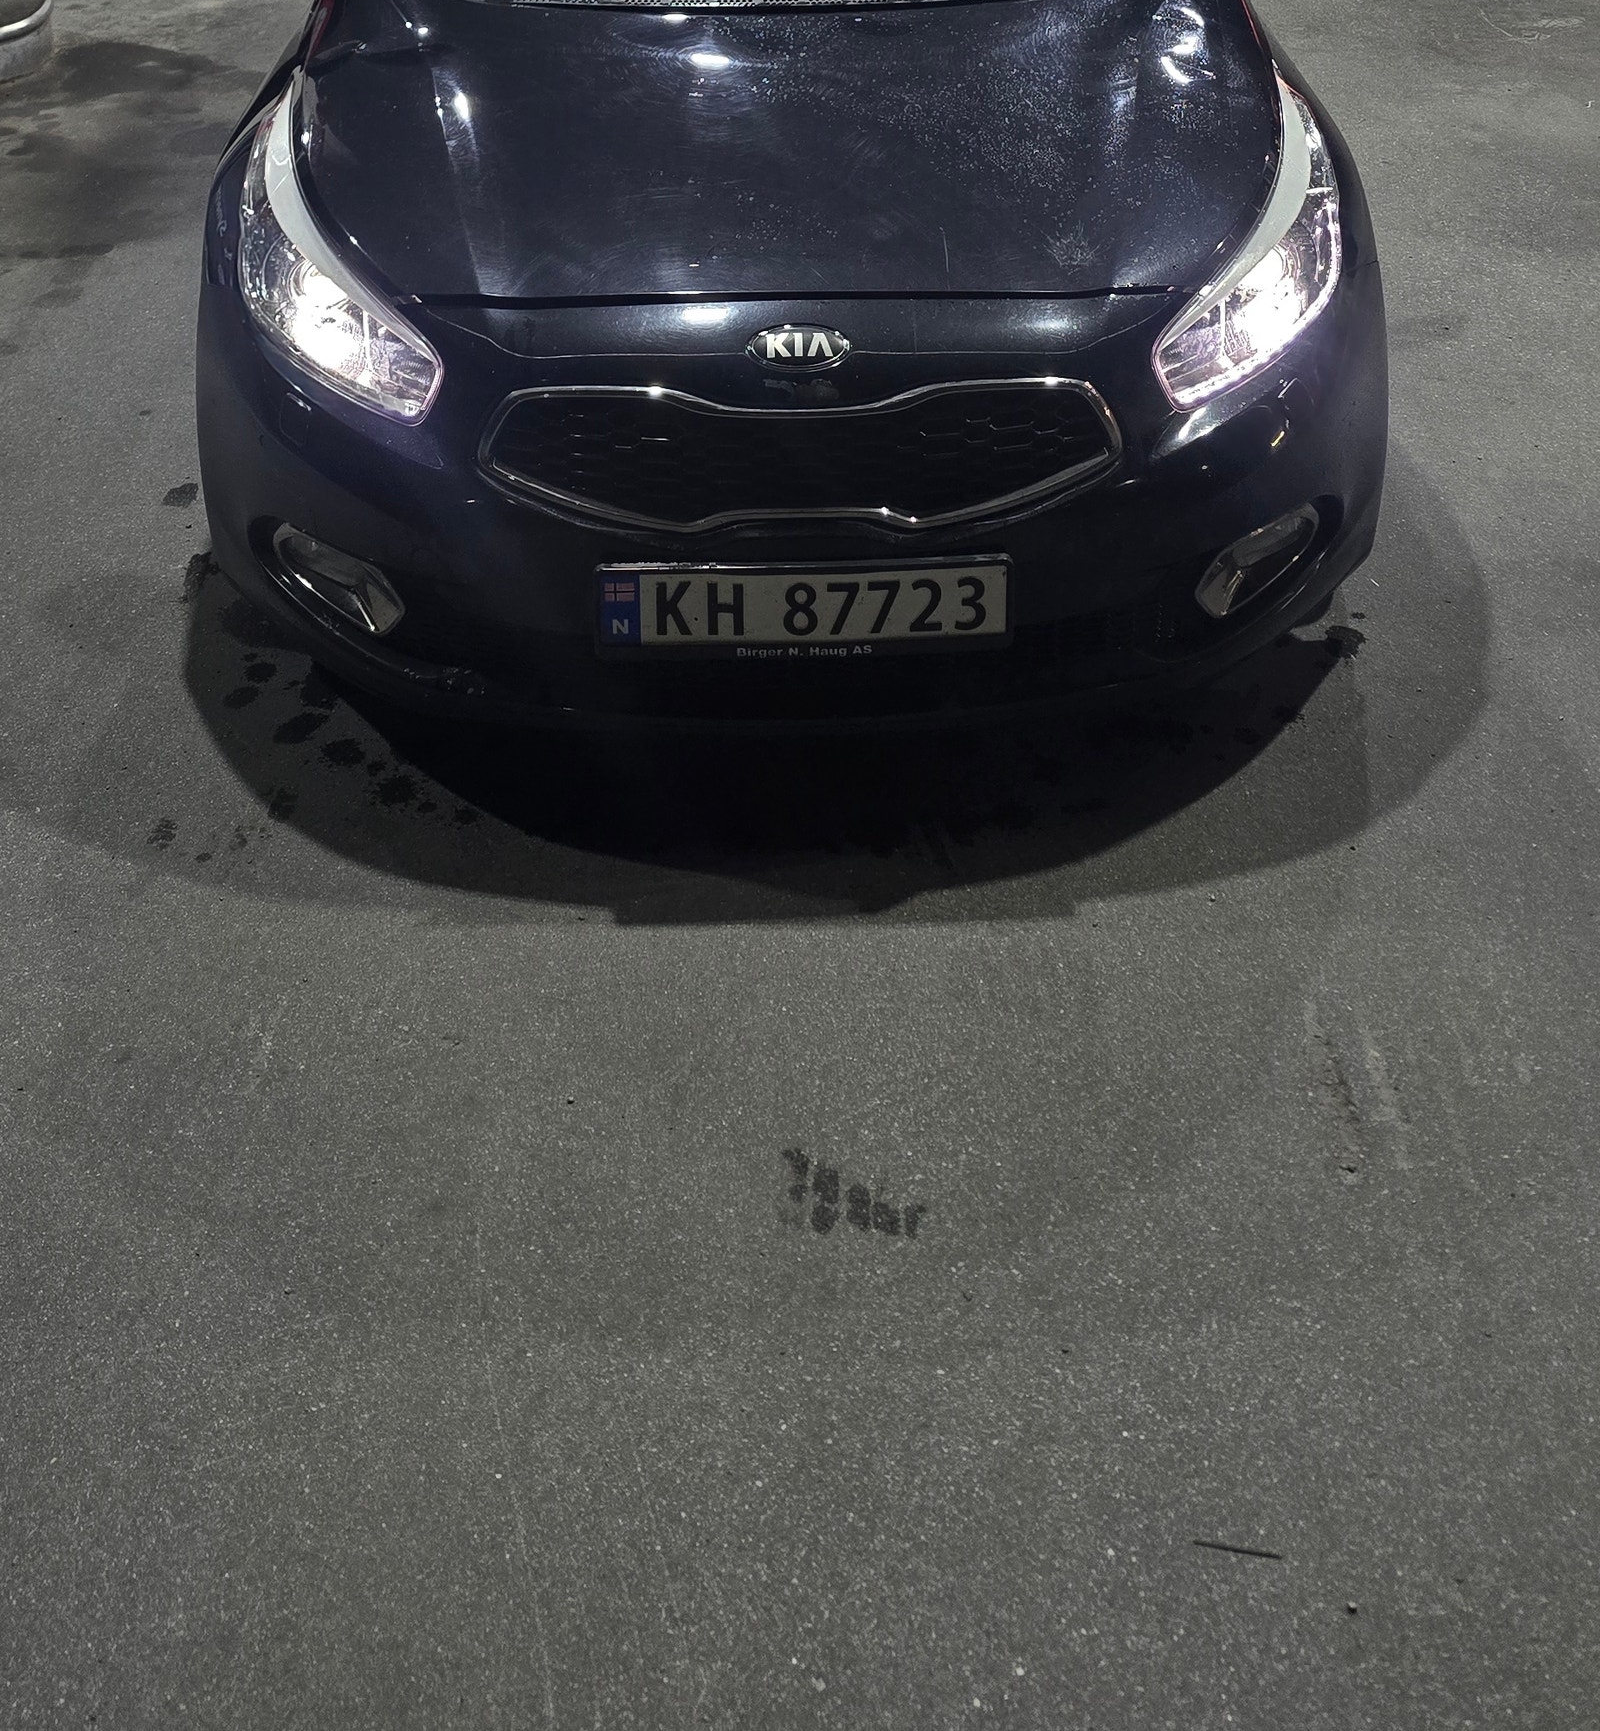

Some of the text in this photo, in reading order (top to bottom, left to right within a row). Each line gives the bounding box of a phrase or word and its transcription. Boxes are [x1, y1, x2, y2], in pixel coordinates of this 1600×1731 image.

[765, 332, 834, 359] KIA
[656, 575, 987, 636] KH 87723
[612, 618, 629, 635] N
[736, 644, 873, 659] Birger N. Haug AS
